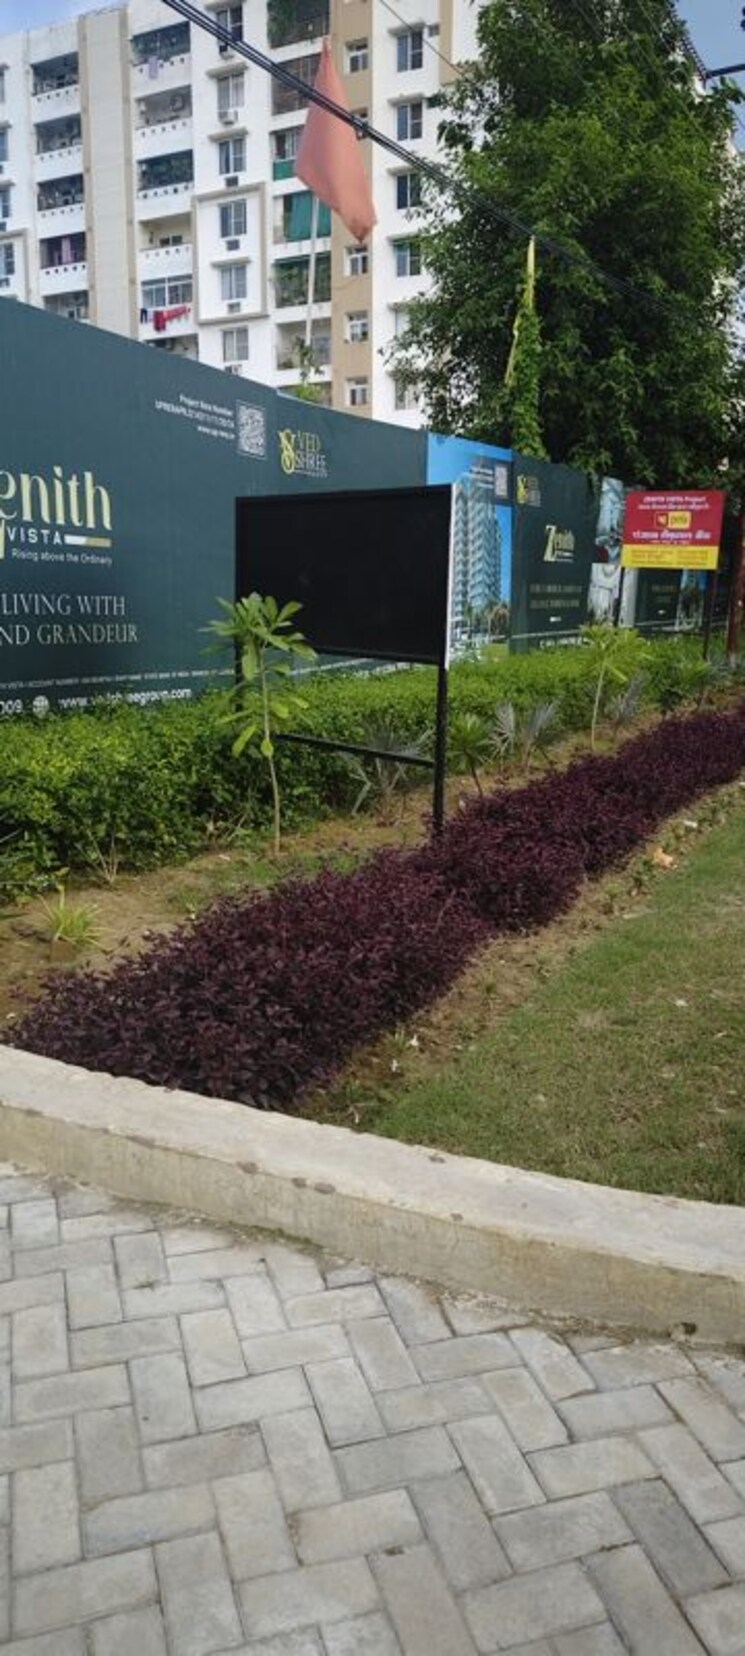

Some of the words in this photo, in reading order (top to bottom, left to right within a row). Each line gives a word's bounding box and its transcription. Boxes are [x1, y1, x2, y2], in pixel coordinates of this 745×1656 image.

[296, 430, 321, 452] VED
[295, 450, 327, 470] SHREE
[6, 527, 62, 545] VISTA
[12, 548, 38, 562] Rising
[41, 550, 65, 562] above
[66, 552, 79, 563] the
[81, 553, 113, 567] Ordinary
[2, 593, 71, 615] LIVING
[77, 595, 125, 616] WITH
[0, 624, 30, 645] ND
[37, 623, 138, 645] GRANDEUR
